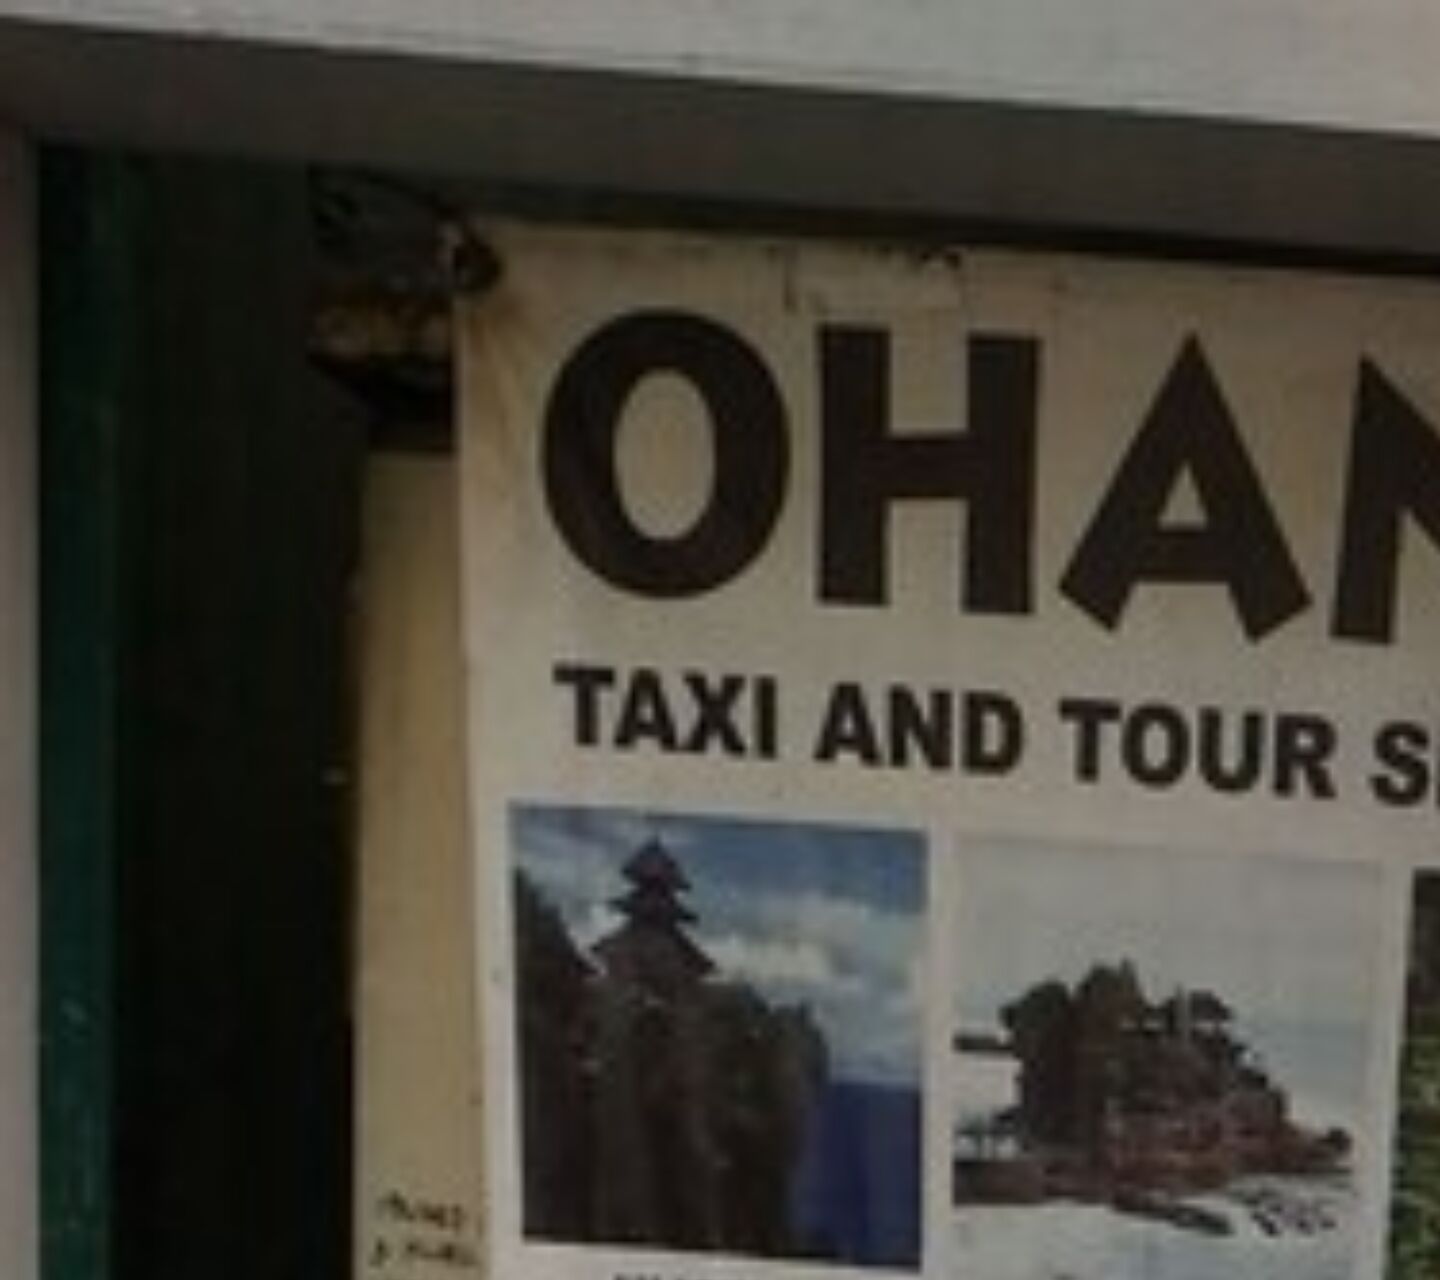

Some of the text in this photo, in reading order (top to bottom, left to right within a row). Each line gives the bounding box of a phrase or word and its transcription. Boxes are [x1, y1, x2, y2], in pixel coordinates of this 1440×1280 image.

[554, 665, 778, 758] TAXI
[814, 682, 1024, 778] AND
[1058, 698, 1334, 798] TOUR
